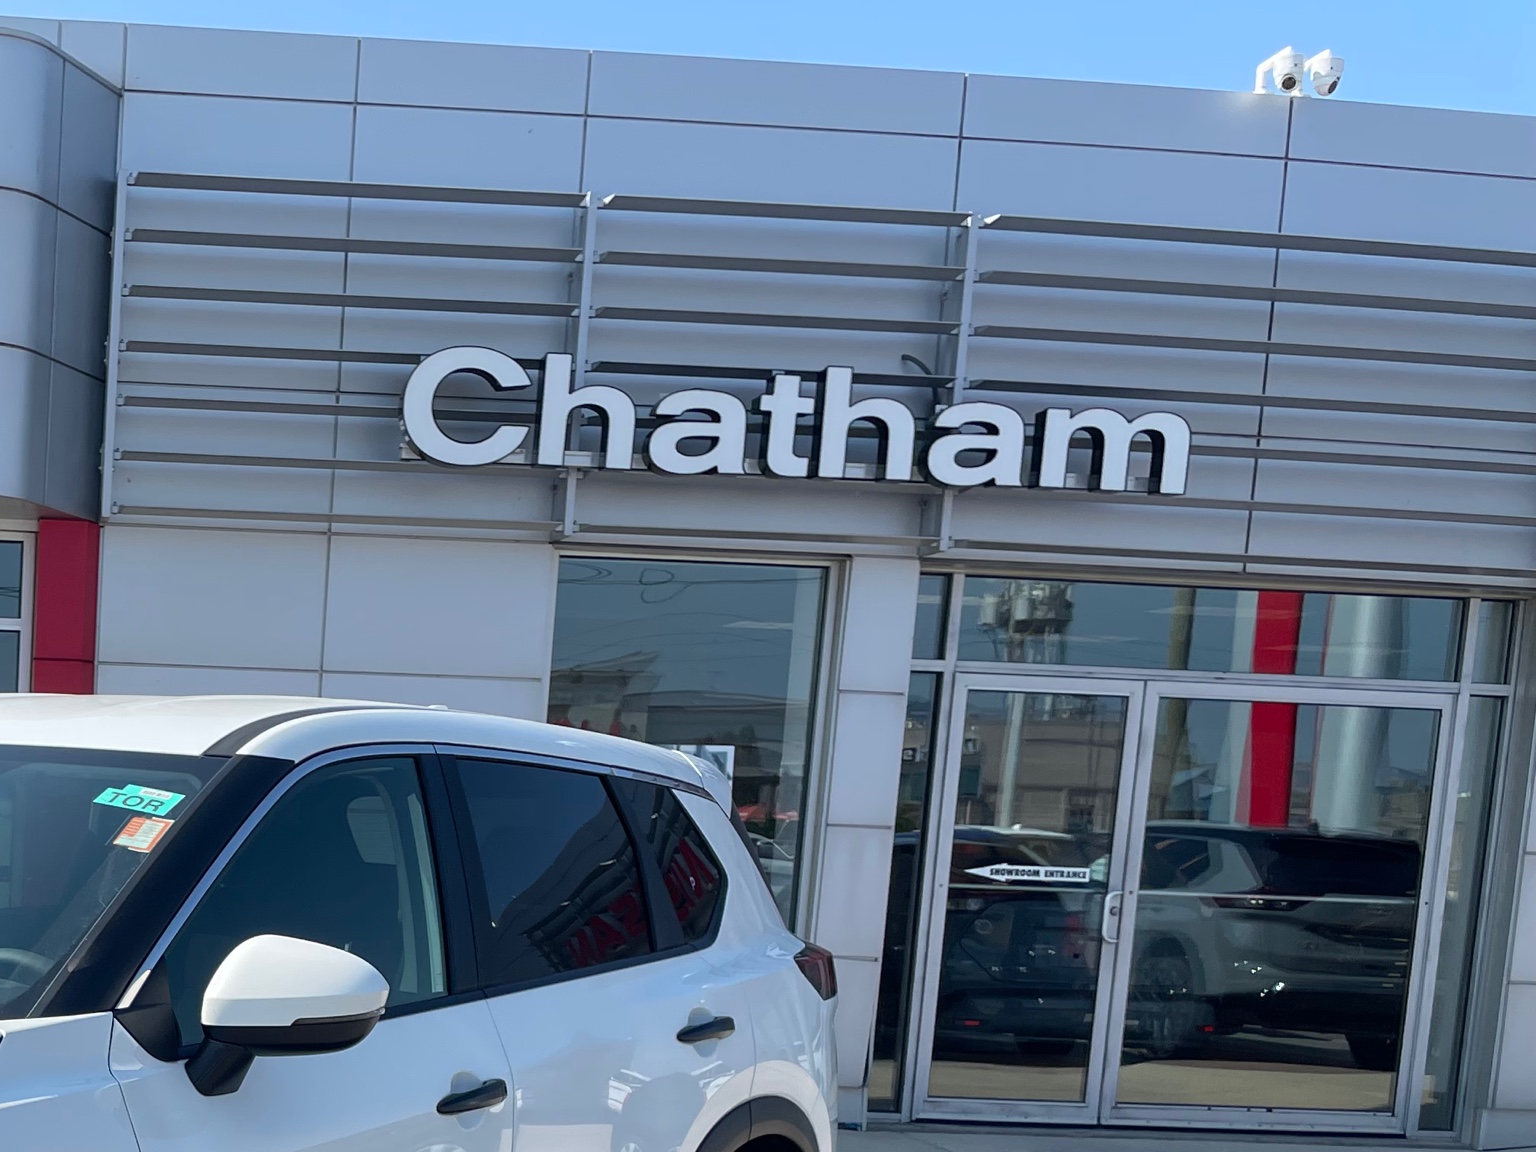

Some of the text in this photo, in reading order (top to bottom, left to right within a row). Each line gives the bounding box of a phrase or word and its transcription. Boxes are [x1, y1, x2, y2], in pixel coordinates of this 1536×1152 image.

[400, 345, 1192, 496] Chatham
[108, 791, 166, 812] TOR
[989, 868, 1088, 879] SHOWROOM ENTRANCE
